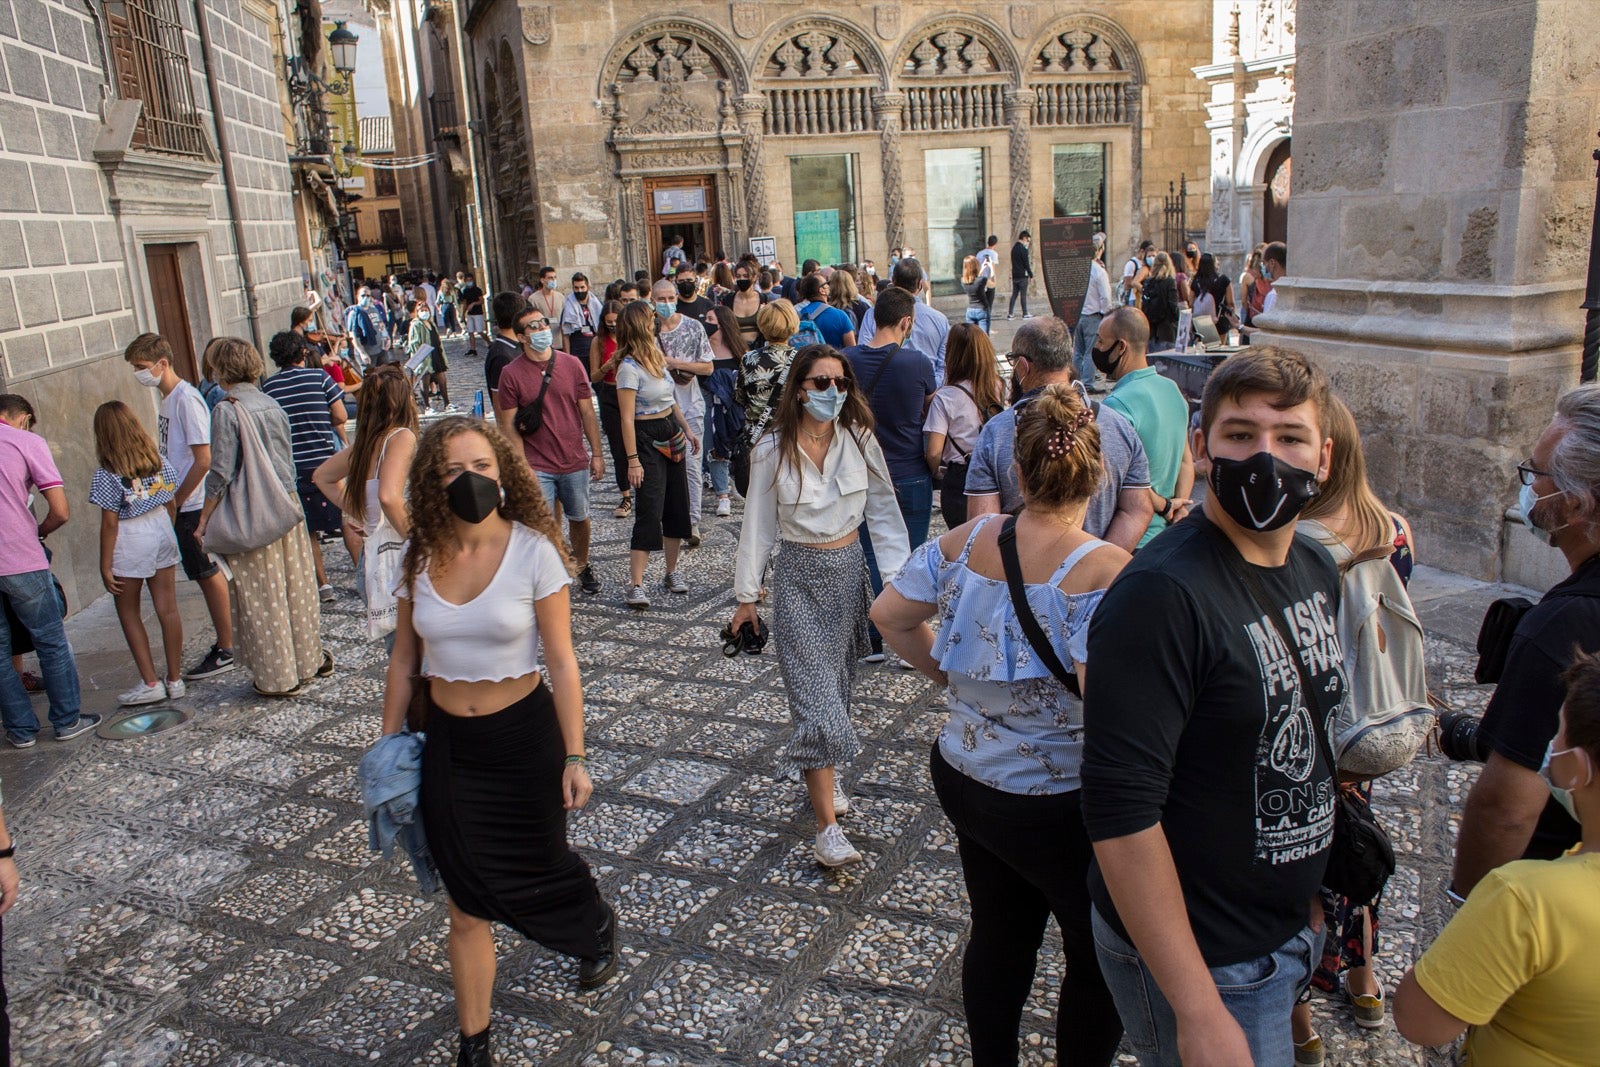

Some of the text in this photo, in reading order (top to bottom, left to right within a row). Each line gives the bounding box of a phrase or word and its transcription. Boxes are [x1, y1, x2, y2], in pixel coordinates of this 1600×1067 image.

[1263, 634, 1344, 697] FESIVAL
[1259, 782, 1314, 816] ON
[1256, 815, 1298, 831] L.A.
